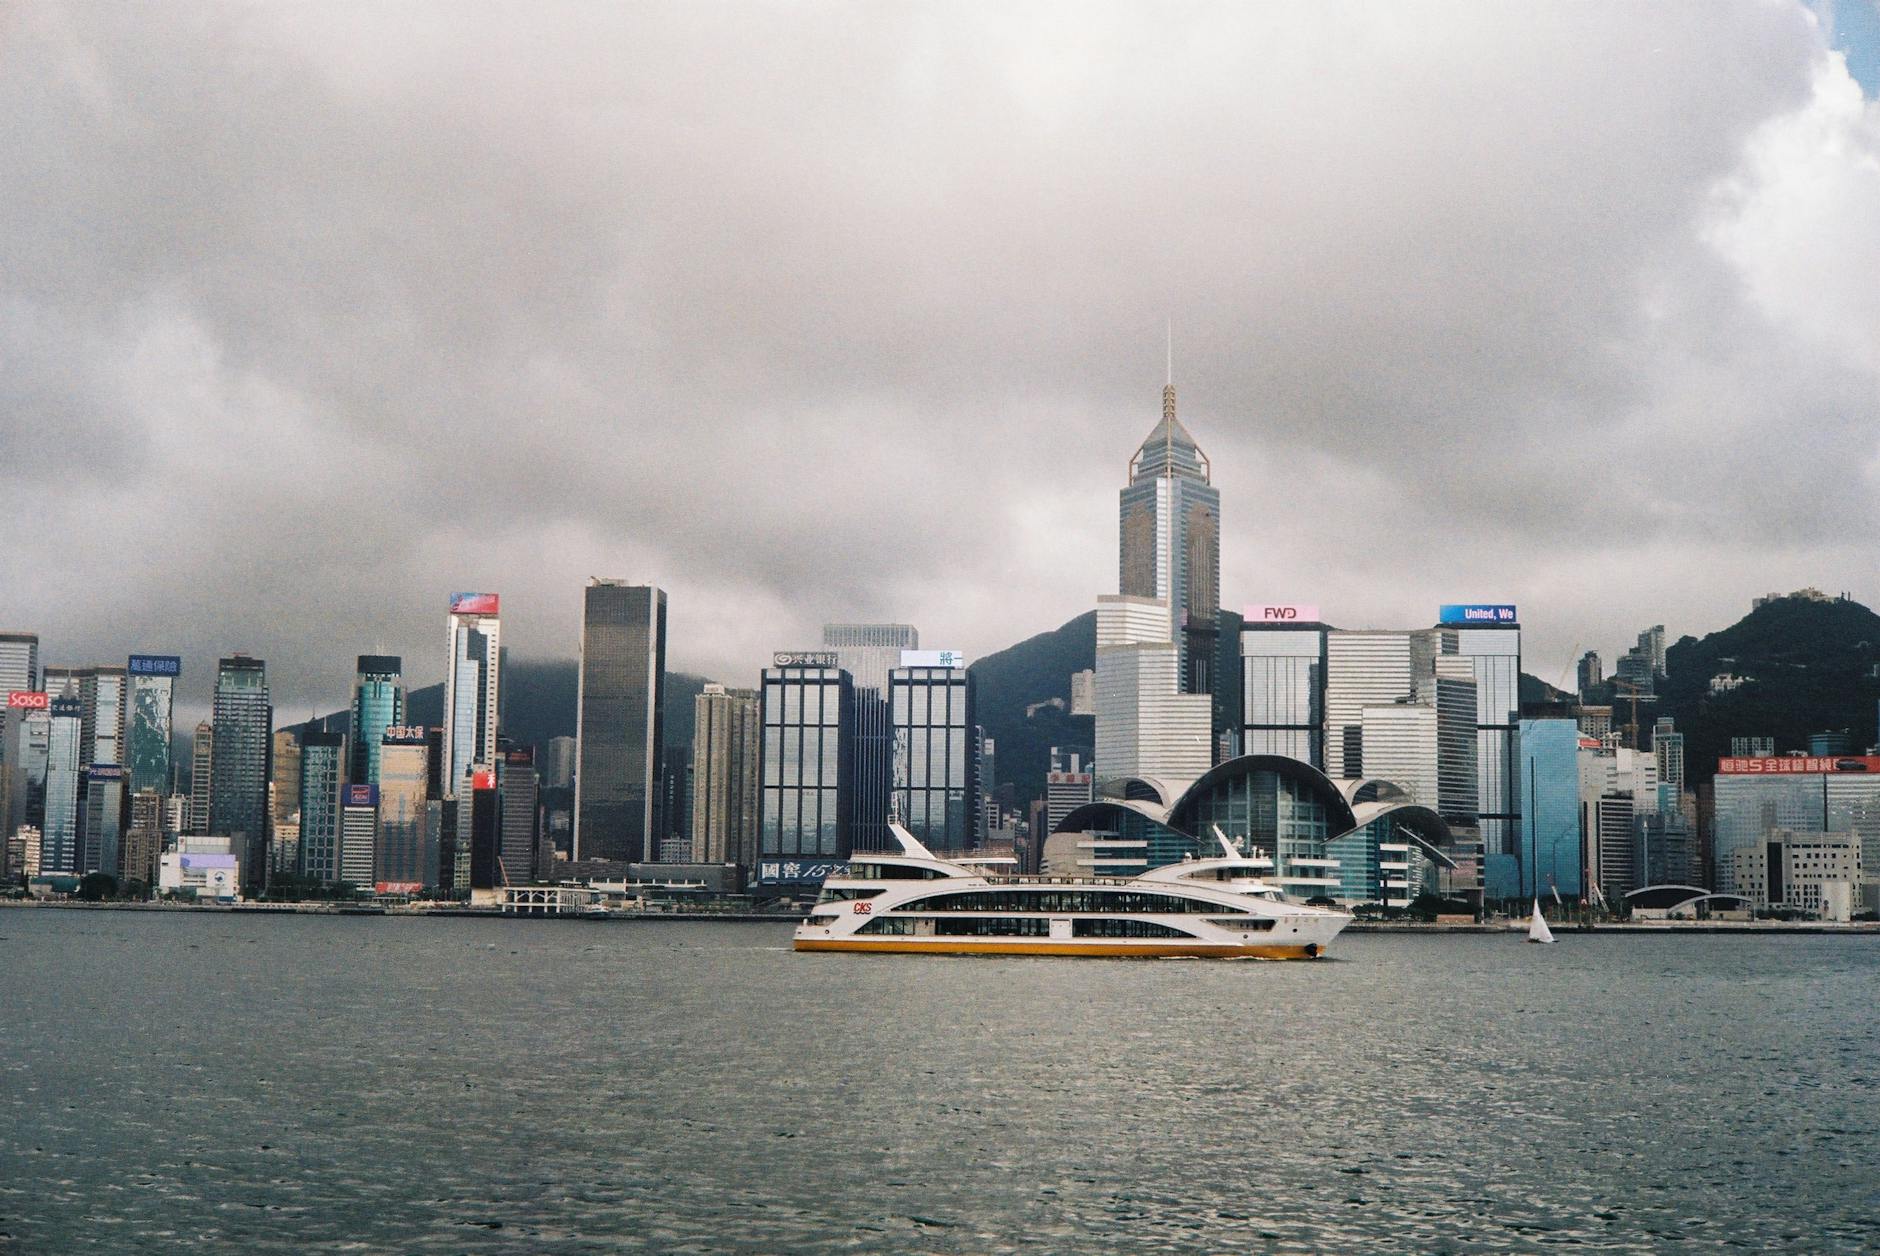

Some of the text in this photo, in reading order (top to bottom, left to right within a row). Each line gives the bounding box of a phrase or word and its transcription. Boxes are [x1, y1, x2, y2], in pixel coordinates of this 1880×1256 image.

[1264, 607, 1297, 619] FWD
[1464, 608, 1514, 620] United, We
[791, 654, 837, 665] 兴业银行
[386, 725, 424, 739] 中国太保
[761, 862, 801, 879] 國窖
[853, 902, 872, 914] CKS
